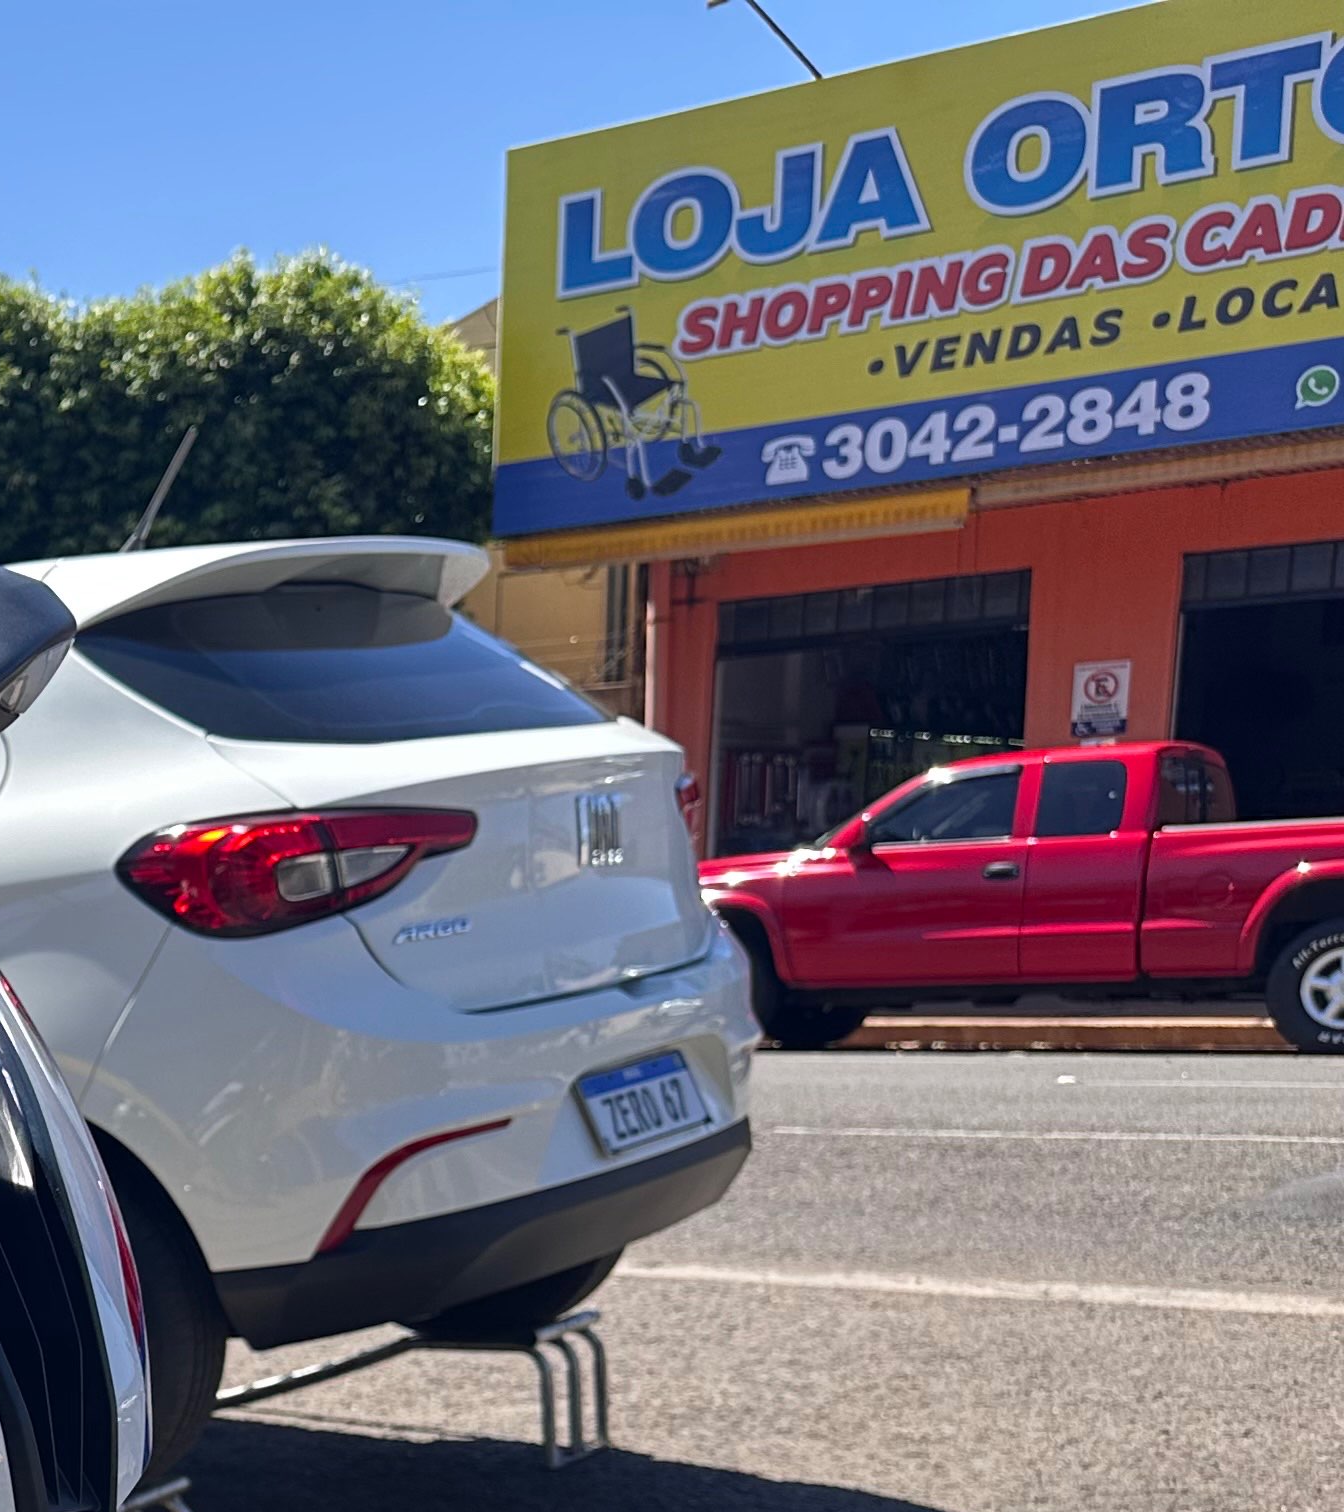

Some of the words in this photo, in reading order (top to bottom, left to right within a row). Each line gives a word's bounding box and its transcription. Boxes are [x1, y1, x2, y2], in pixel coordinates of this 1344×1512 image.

[558, 130, 929, 298] LOJA
[967, 32, 1344, 213] ORT
[676, 250, 1012, 356] SHOPPING
[1018, 221, 1173, 299] DAS
[1183, 190, 1344, 268] CAD
[892, 308, 1122, 378] VENDAS
[822, 371, 1211, 480] 3042-2848
[394, 917, 472, 944] ARGO
[602, 1086, 663, 1140] ZERO
[660, 1077, 689, 1122] 67
